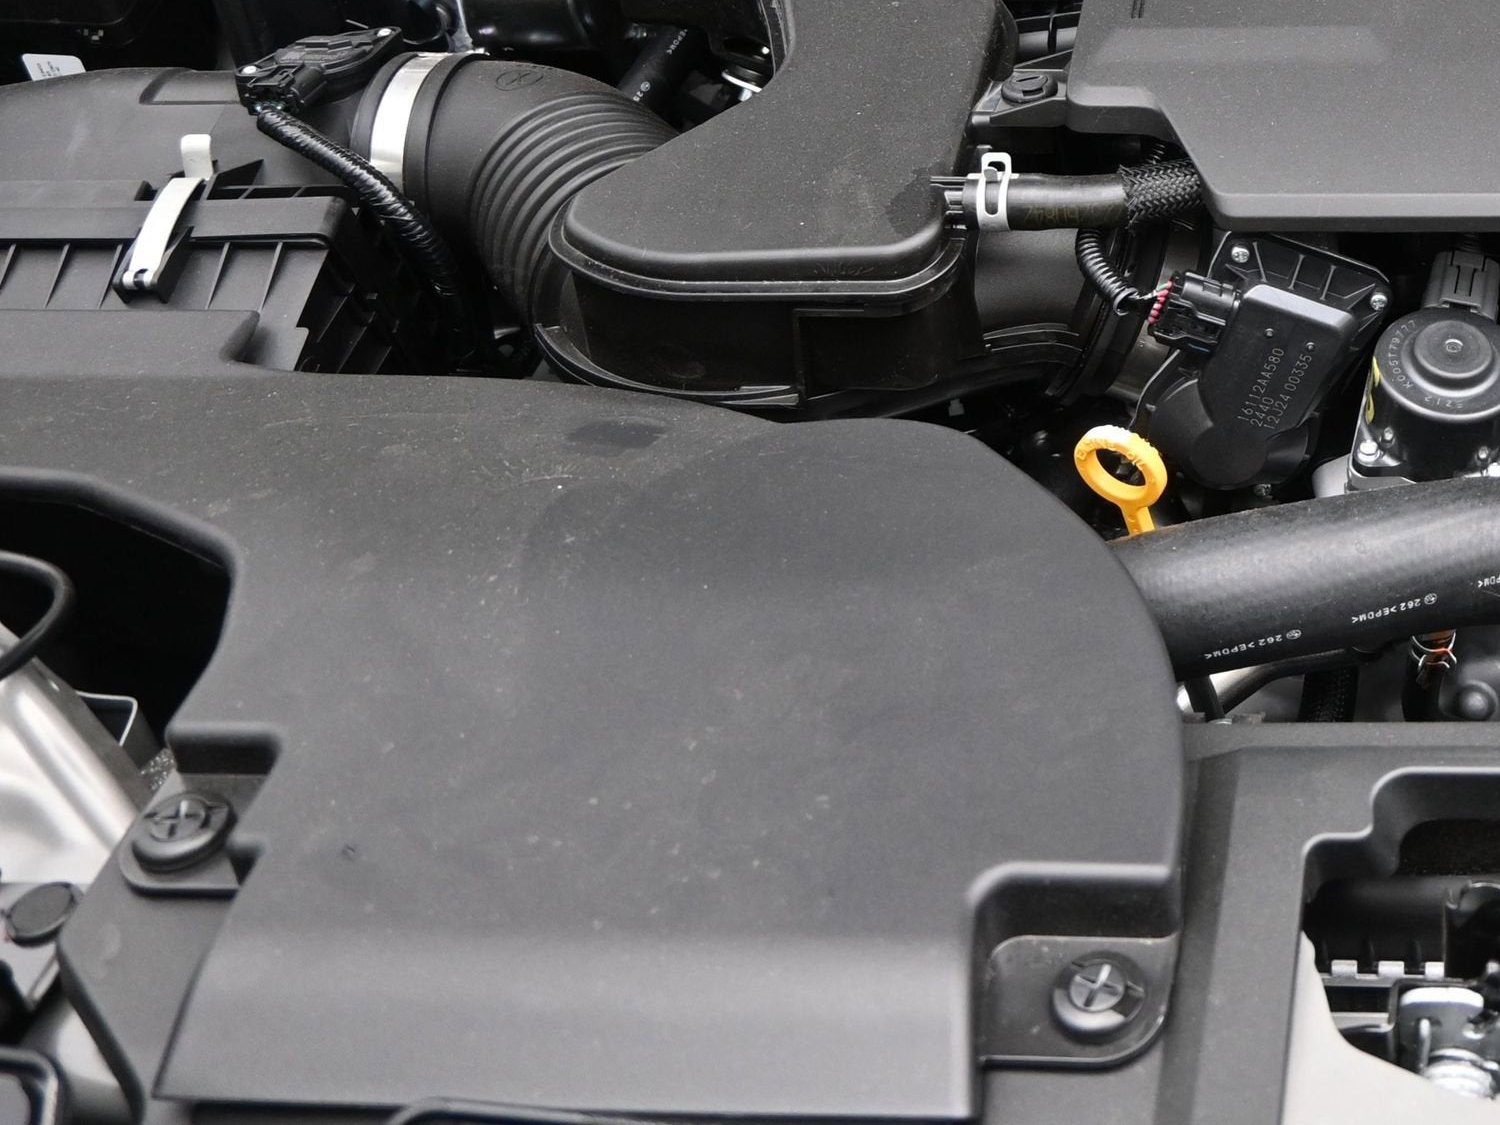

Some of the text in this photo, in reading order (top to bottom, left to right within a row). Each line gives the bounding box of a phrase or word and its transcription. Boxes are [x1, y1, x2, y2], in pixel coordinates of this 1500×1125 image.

[1237, 347, 1285, 422] 16112AA580
[1263, 352, 1313, 430] 12J24 00335
[1250, 397, 1275, 428] 2440
[1398, 597, 1423, 613] 262
[1257, 633, 1284, 647] 262
